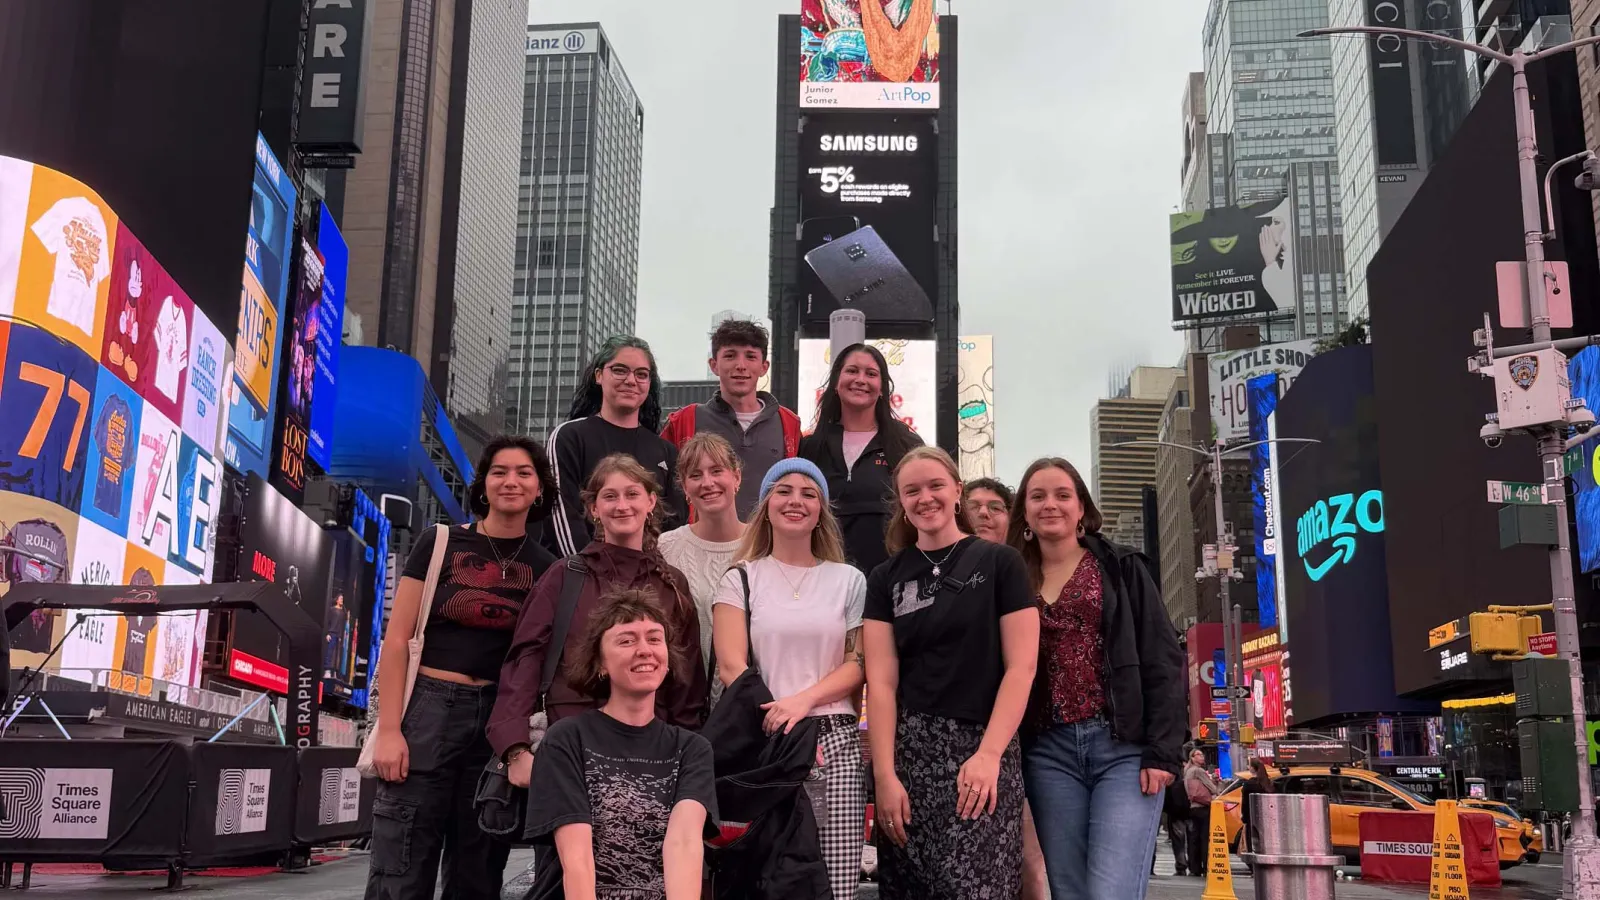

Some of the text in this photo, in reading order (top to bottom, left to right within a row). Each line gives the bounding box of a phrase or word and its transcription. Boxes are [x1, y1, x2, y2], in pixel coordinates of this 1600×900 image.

[310, 0, 353, 108] RE
[805, 85, 834, 94] Junior
[805, 96, 838, 104] Gomez
[820, 134, 918, 152] SAMSUNG
[820, 166, 855, 193] 5%
[1176, 280, 1212, 290] Remember
[1219, 274, 1256, 285] FOREVER.
[1194, 272, 1208, 280] See
[1216, 268, 1235, 277] LIVE.
[1220, 348, 1271, 382] LITTLE
[18, 361, 91, 473] 77
[284, 417, 308, 461] LOST
[281, 445, 304, 488] BOYS
[1502, 484, 1540, 502] W 46 St
[1263, 468, 1274, 537] Checkout.com
[1296, 489, 1385, 557] amazo
[252, 550, 277, 583] MORE
[79, 619, 104, 645] EAGLE
[1440, 649, 1450, 658] THE
[1531, 643, 1553, 651] Anytime
[1440, 652, 1468, 670] SQUARE
[125, 701, 166, 720] AMERICAN
[169, 710, 191, 725] EAGLE
[57, 783, 99, 796] Times
[248, 783, 265, 794] Times
[344, 779, 357, 790] Times
[246, 795, 265, 808] Square
[343, 790, 357, 800] Square
[52, 797, 101, 812] Square
[52, 813, 98, 824] Alliance
[246, 808, 264, 819] Alliance
[1376, 843, 1406, 853] TIMES
